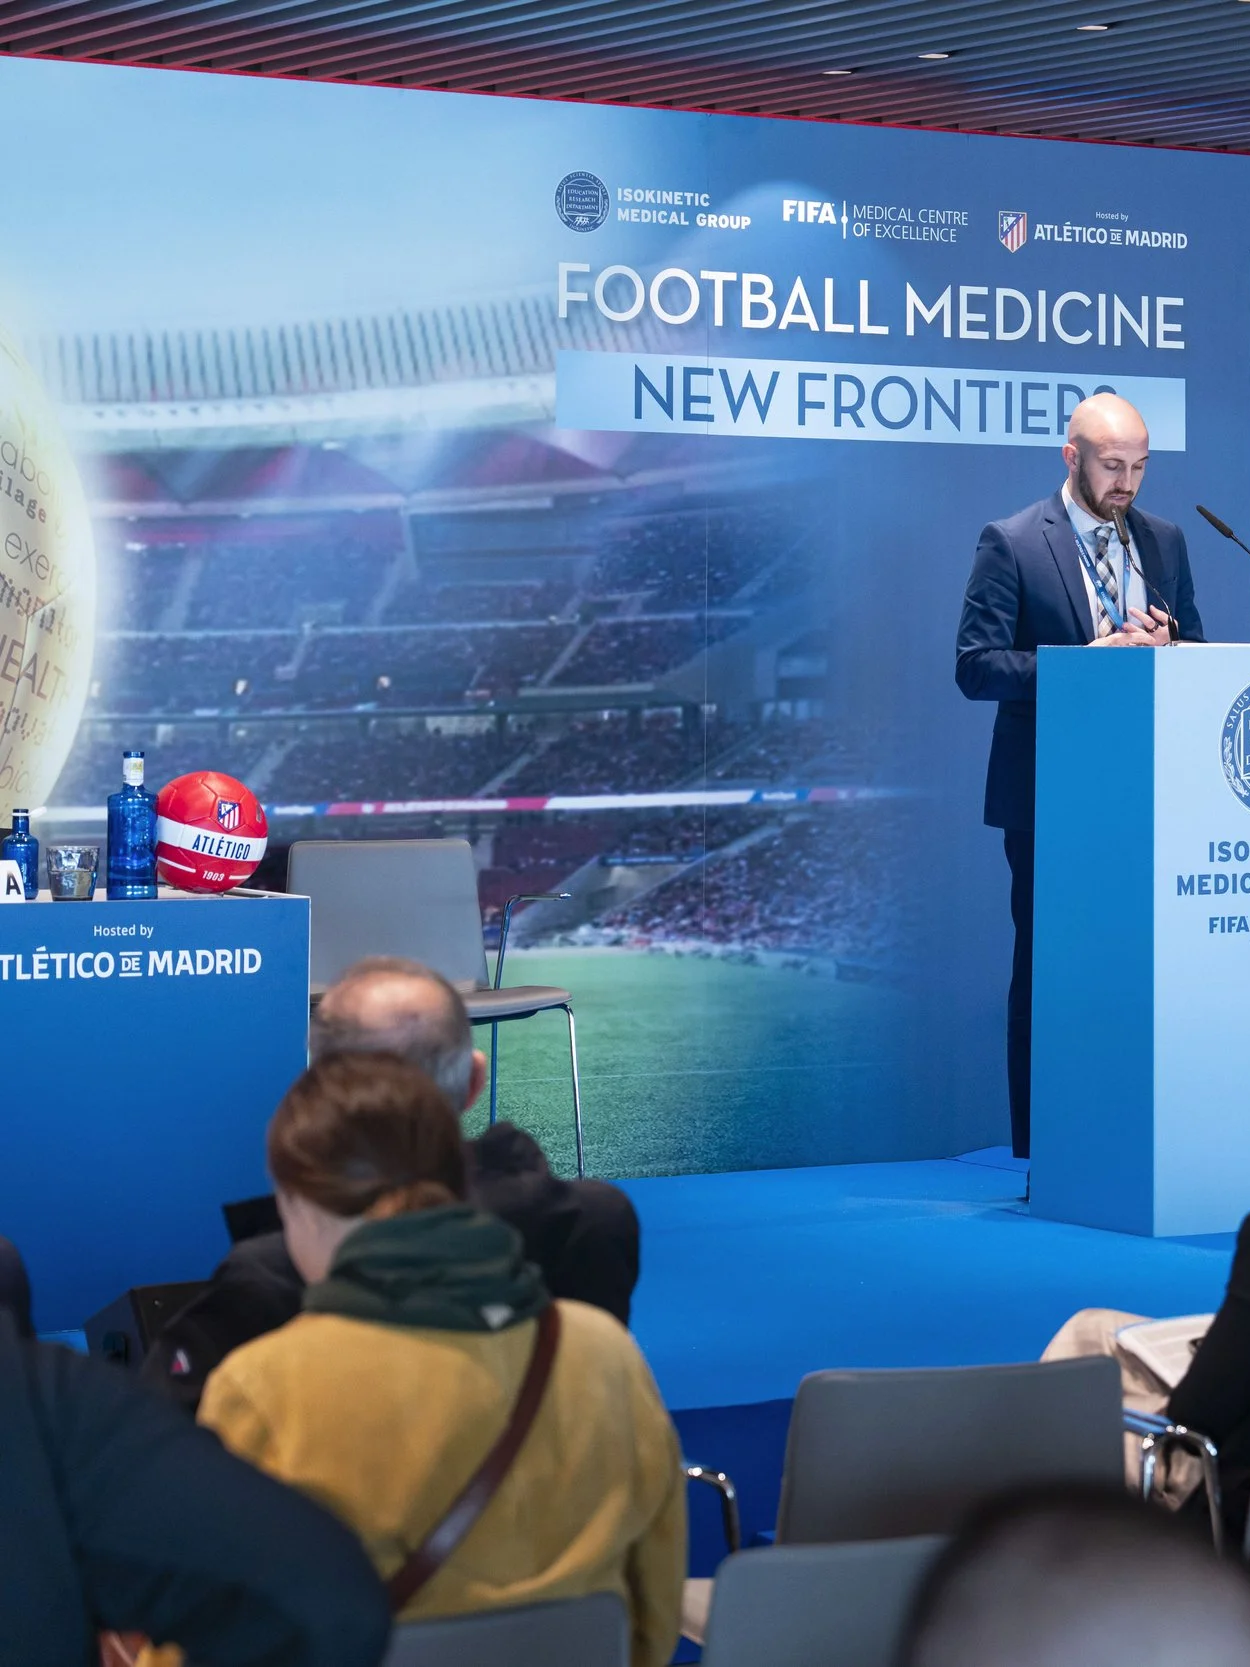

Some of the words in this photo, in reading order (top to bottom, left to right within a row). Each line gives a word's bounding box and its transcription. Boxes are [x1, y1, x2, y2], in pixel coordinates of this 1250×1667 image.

[617, 187, 711, 207] ISOKINETIC
[617, 208, 689, 226] MEDICAL
[696, 213, 751, 230] GROUP
[783, 199, 837, 224] FIFA
[853, 204, 915, 222] MEDICAL
[918, 209, 969, 226] CENTRE
[1095, 211, 1119, 220] Hosted
[1120, 212, 1129, 223] by
[853, 222, 871, 237] OF
[875, 224, 957, 242] EXCELLENCE
[1034, 221, 1108, 244] ATLÉTICO
[1111, 232, 1122, 242] DE
[1125, 229, 1188, 249] MADRID
[557, 262, 889, 335] FOOTBALL
[906, 282, 1186, 350] MEDICINE
[633, 363, 781, 425] NEW
[798, 373, 1117, 436] FRONTIER
[1226, 692, 1250, 729] SALUS
[192, 834, 251, 861] ATLÉTICO
[202, 870, 226, 882] 1903
[93, 924, 136, 937] Hosted
[139, 923, 154, 939] by
[1208, 915, 1250, 934] FIFA
[121, 956, 141, 972] DE
[147, 948, 262, 977] MADRID
